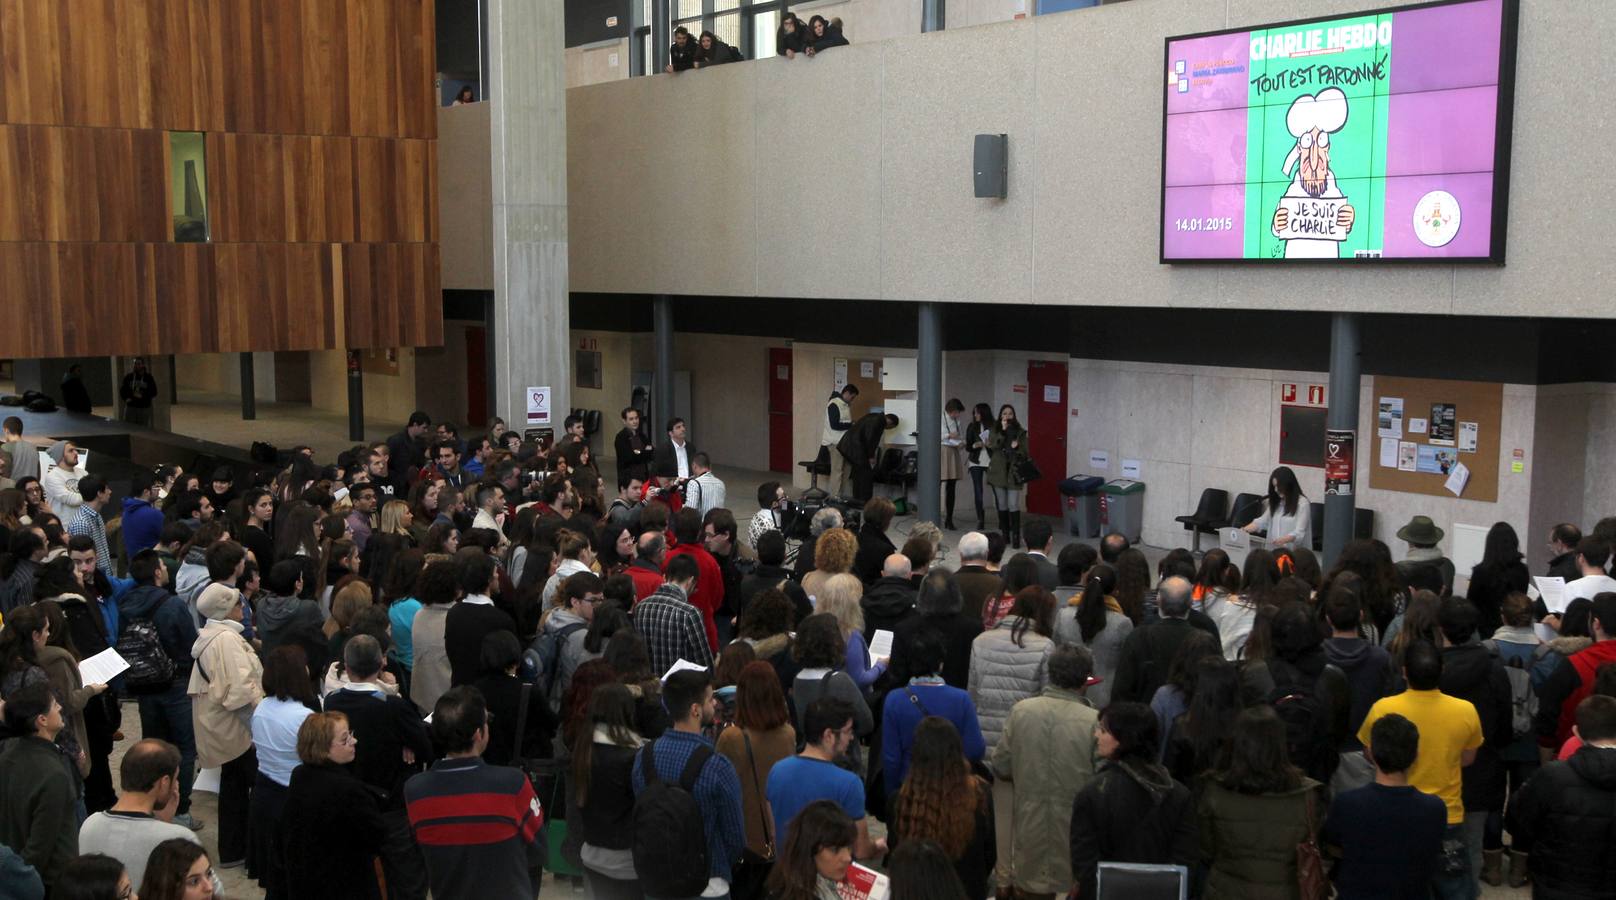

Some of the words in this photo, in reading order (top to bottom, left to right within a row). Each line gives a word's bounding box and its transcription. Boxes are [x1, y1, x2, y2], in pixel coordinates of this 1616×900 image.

[1250, 29, 1324, 60] CHARLIE
[1327, 21, 1392, 51] HEBDO
[1250, 69, 1289, 96] TOUT
[1289, 64, 1316, 89] EST
[1317, 53, 1388, 86] PARDONNÉ
[1293, 201, 1310, 217] JE
[1175, 217, 1232, 231] 14.01.2015
